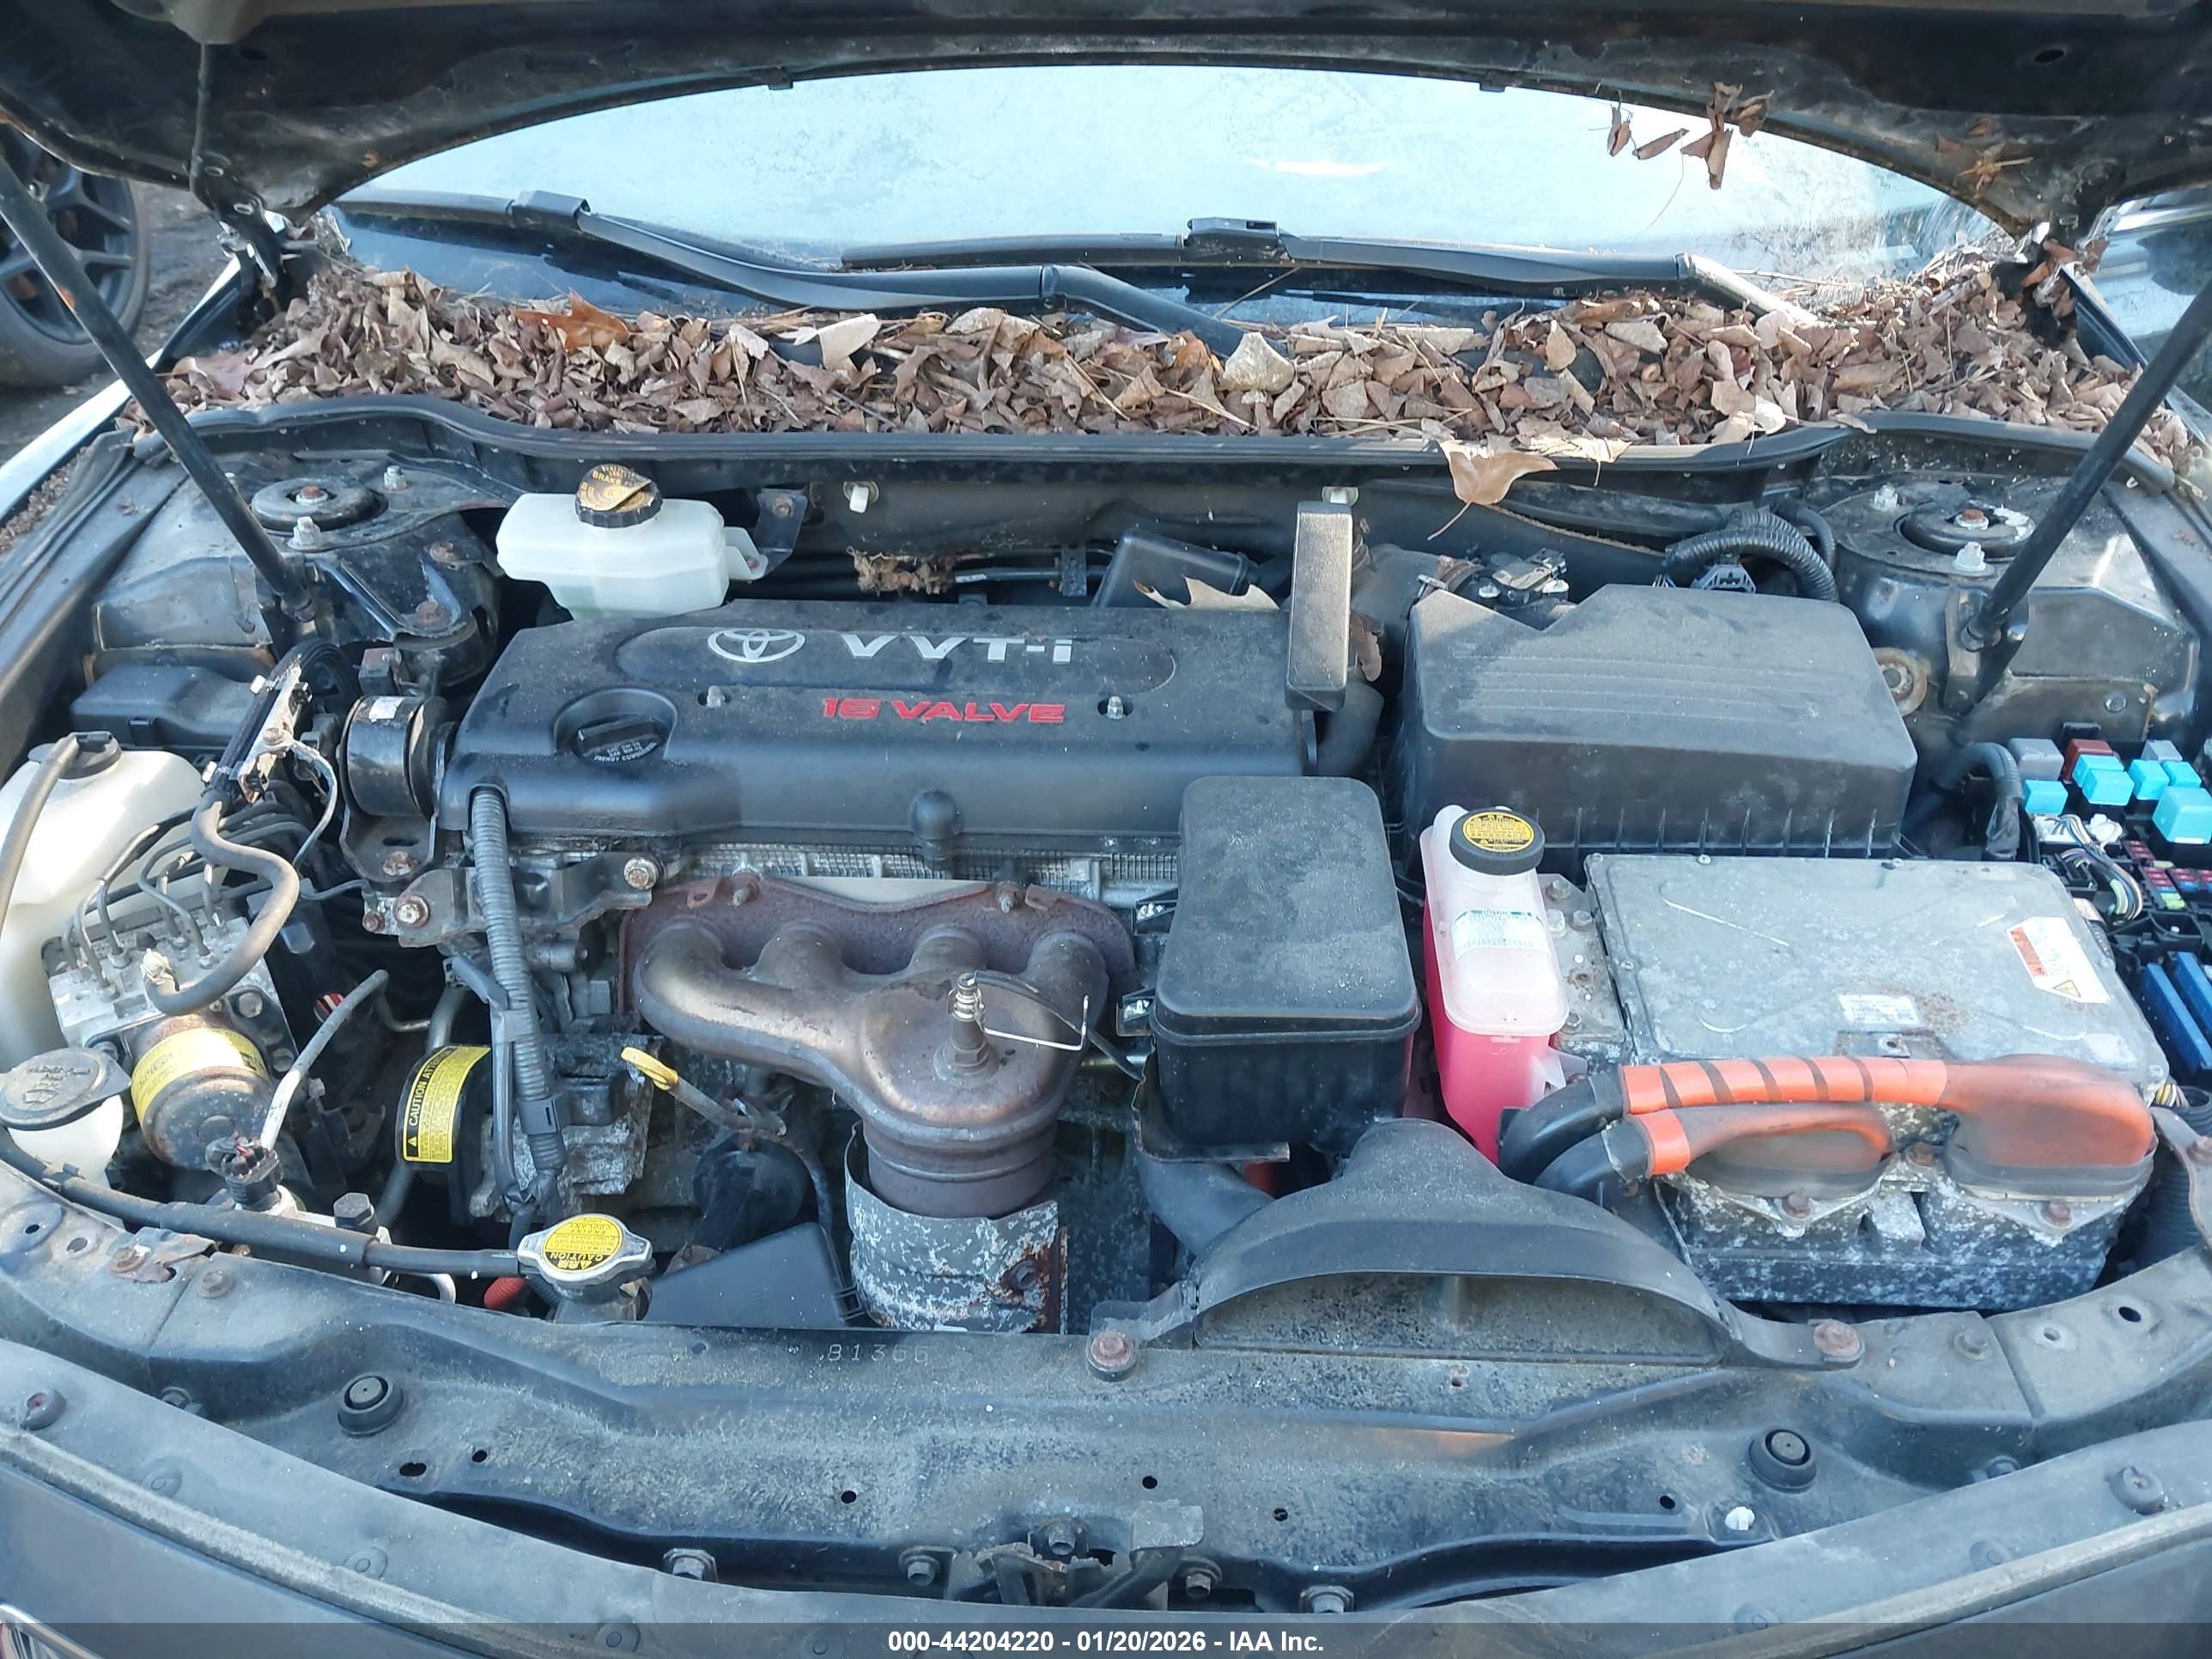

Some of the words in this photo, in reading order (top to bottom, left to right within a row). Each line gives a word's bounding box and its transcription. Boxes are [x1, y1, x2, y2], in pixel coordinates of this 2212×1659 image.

[840, 634, 1073, 663] VVT-i
[823, 697, 881, 720] 16
[891, 700, 1066, 722] VALVE
[409, 1080, 428, 1127] CAUTION
[550, 1252, 604, 1261] CAUTION
